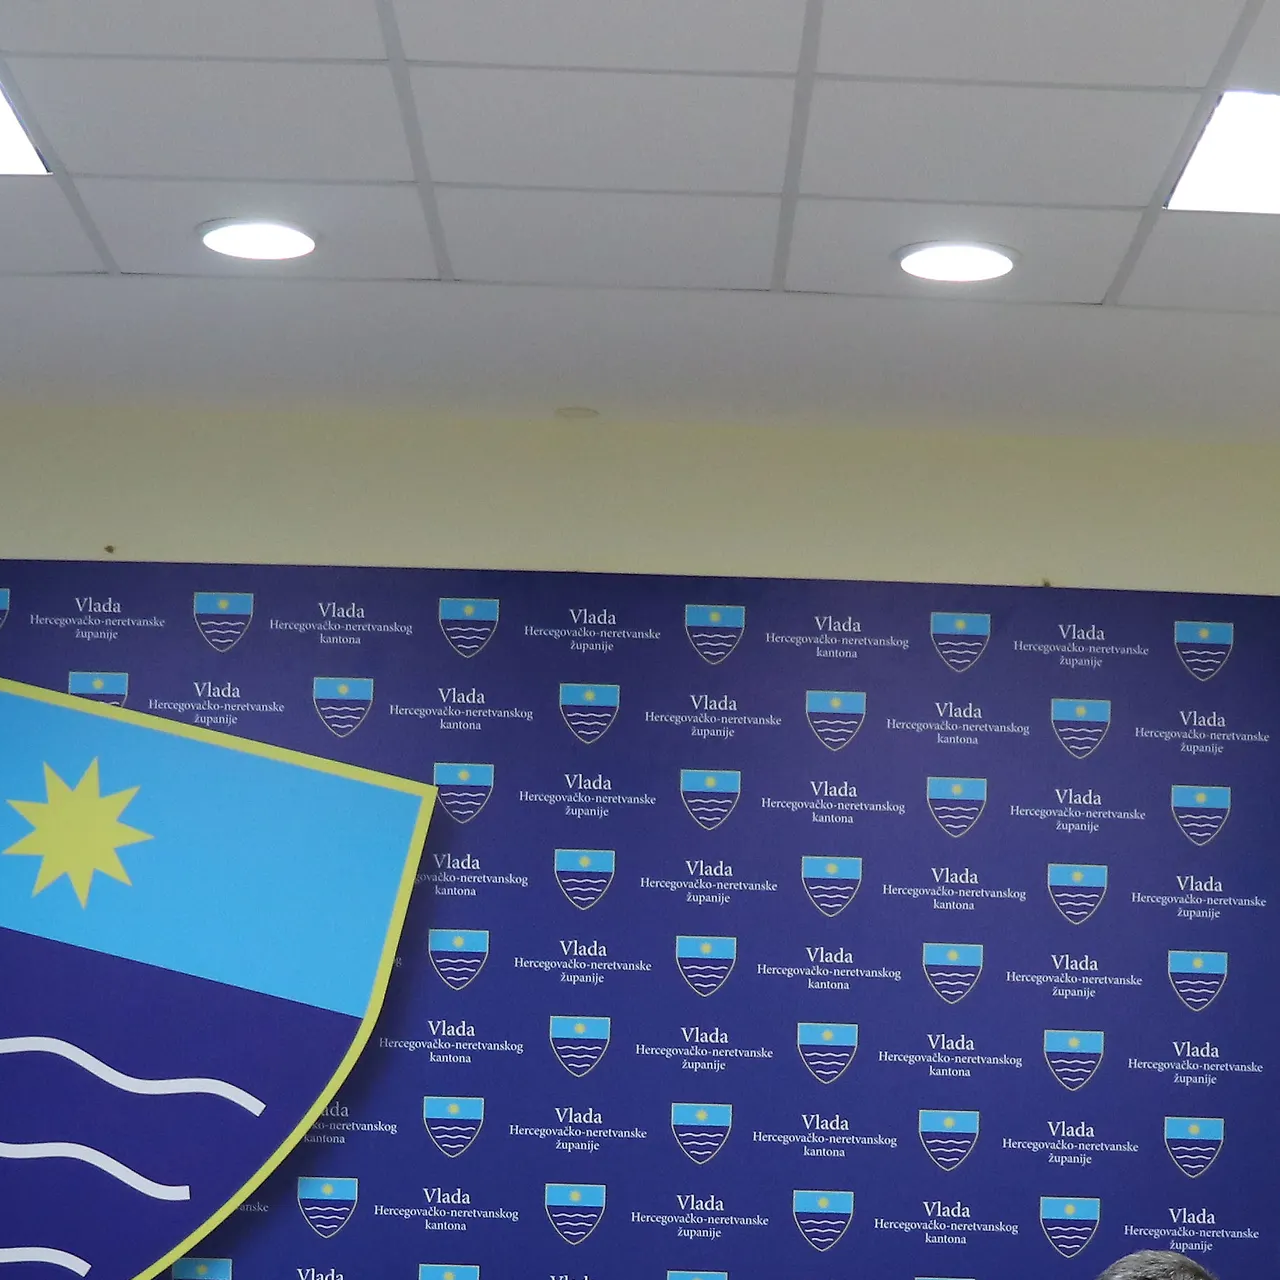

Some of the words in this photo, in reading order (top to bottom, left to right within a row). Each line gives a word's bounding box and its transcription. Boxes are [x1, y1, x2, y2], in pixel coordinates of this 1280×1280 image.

[74, 596, 122, 614] Vlada
[318, 601, 365, 619] Vlada
[30, 614, 166, 628] Hercegovačko-neretvanske
[568, 608, 617, 625] Vlada
[814, 615, 862, 633] Vlada
[75, 628, 119, 642] županije
[269, 618, 413, 636] Hercegovačko-neretvanskog
[524, 625, 661, 640] Hercegovačko-neretvanske
[1057, 623, 1106, 641] Vlada
[319, 632, 361, 645] kantona
[570, 639, 614, 654] županije
[766, 632, 910, 650] Hercegovačko-neretvanskog
[816, 646, 858, 659] kantona
[1013, 640, 1149, 656] Hercegovačko-neretvanske
[1059, 655, 1103, 669] županije
[193, 681, 241, 698] Vlada
[437, 687, 486, 705] Vlada
[148, 698, 285, 713] Hercegovačko-neretvanske
[689, 694, 738, 711] Vlada
[934, 701, 983, 719] Vlada
[194, 714, 238, 727] županije
[389, 704, 534, 722] Hercegovačko-neretvanskog
[645, 711, 782, 726] Hercegovačko-neretvanske
[1179, 710, 1226, 728] Vlada
[439, 718, 482, 730] kantona
[886, 718, 1030, 737] Hercegovačko-neretvanskog
[691, 725, 735, 740] županije
[937, 732, 979, 745] kantona
[1135, 727, 1270, 742] Hercegovačko-neretvanske
[1180, 741, 1224, 756] županije
[564, 773, 612, 791] Vlada
[809, 780, 858, 798] Vlada
[519, 790, 657, 806] Hercegovačko-neretvanske
[1054, 788, 1102, 806] Vlada
[565, 805, 610, 819] županije
[761, 797, 906, 815] Hercegovačko-neretvanskog
[1010, 805, 1146, 820] Hercegovačko-neretvanske
[812, 811, 854, 824] kantona
[1055, 820, 1100, 834] županije
[433, 852, 481, 870] Vlada
[685, 859, 734, 877] Vlada
[415, 872, 529, 888] govačko-neretvanskog
[640, 876, 778, 892] Hercegovačko-neretvanske
[930, 867, 979, 885] Vlada
[1175, 875, 1223, 893] Vlada
[434, 884, 477, 896] kantona
[882, 884, 1027, 902] Hercegovačko-neretvanskog
[686, 891, 731, 906] županije
[933, 898, 975, 911] kantona
[1131, 891, 1267, 907] Hercegovačko-neretvanske
[1176, 906, 1221, 921] županije
[559, 939, 608, 957] Vlada
[805, 946, 854, 964] Vlada
[514, 956, 652, 972] Hercegovačko-neretvanske
[1050, 953, 1099, 971] Vlada
[560, 971, 605, 986] županije
[757, 963, 902, 982] Hercegovačko-neretvanskog
[1006, 971, 1143, 986] Hercegovačko-neretvanske
[807, 977, 850, 990] kantona
[1051, 985, 1096, 1000] županije
[427, 1019, 476, 1037] Vlada
[680, 1026, 729, 1044] Vlada
[379, 1037, 524, 1054] Hercegovačko-neretvanskog
[926, 1033, 975, 1051] Vlada
[1172, 1040, 1220, 1058] Vlada
[429, 1051, 472, 1064] kantona
[635, 1043, 774, 1059] Hercegovačko-neretvanske
[681, 1058, 726, 1073] županije
[878, 1050, 1023, 1069] Hercegovačko-neretvanskog
[1127, 1057, 1264, 1073] Hercegovačko-neretvanske
[928, 1064, 971, 1077] kantona
[1173, 1072, 1218, 1087] županije
[554, 1106, 603, 1125] Vlada
[801, 1113, 850, 1131] Vlada
[509, 1124, 648, 1139] Hercegovačko-neretvanske
[1046, 1120, 1095, 1138] Vlada
[555, 1138, 600, 1154] županije
[752, 1130, 898, 1149] Hercegovačko-neretvanskog
[1002, 1137, 1139, 1153] Hercegovačko-neretvanske
[803, 1145, 846, 1157] kantona
[1048, 1152, 1093, 1167] županije
[422, 1187, 471, 1205] Vlada
[676, 1194, 725, 1212] Vlada
[374, 1204, 519, 1223] Hercegovačko-neretvanskog
[922, 1200, 971, 1218] Vlada
[1168, 1207, 1216, 1225] Vlada
[424, 1218, 467, 1231] kantona
[631, 1211, 769, 1227] Hercegovačko-neretvanske
[874, 1217, 1019, 1236] Hercegovačko-neretvanskog
[677, 1226, 722, 1241] županije
[924, 1232, 967, 1245] kantona
[1123, 1224, 1260, 1240] Hercegovačko-neretvanske
[1169, 1239, 1214, 1254] županije
